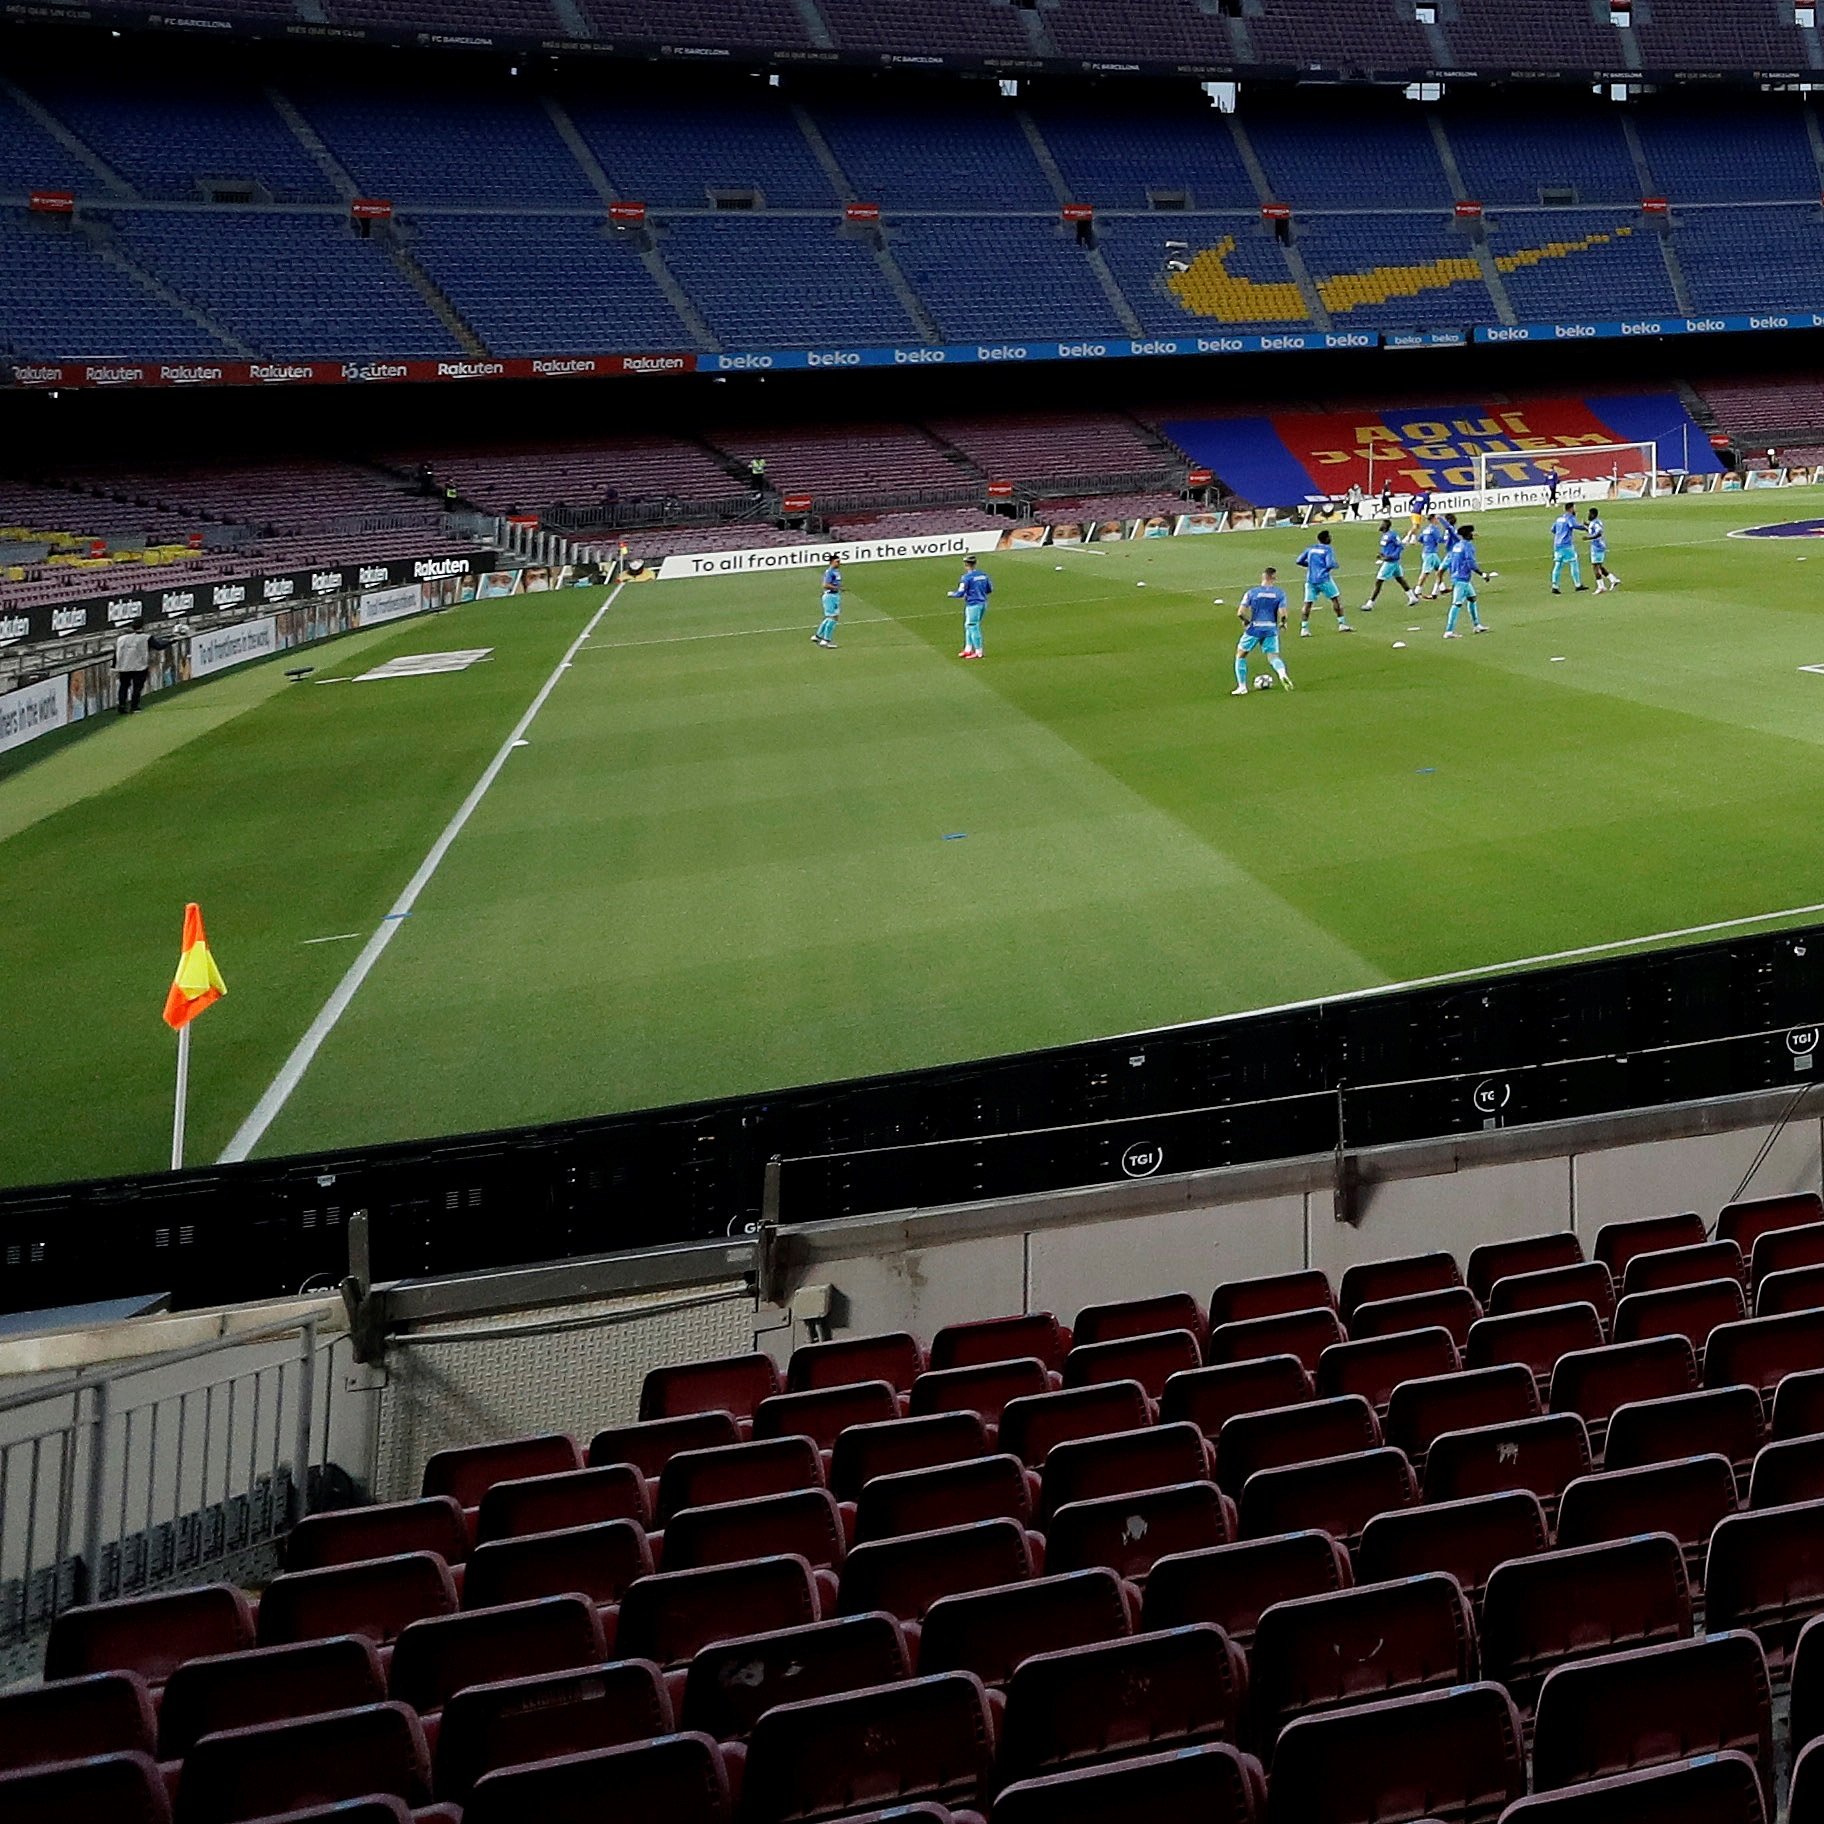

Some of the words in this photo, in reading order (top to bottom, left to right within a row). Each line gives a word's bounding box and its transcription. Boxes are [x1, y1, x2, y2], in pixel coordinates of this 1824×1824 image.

[177, 18, 232, 29] BARCELONA
[1621, 322, 1661, 334] beko
[1686, 320, 1725, 332] beko
[1750, 316, 1788, 328] beko
[1431, 333, 1460, 343] beko
[1487, 327, 1529, 340] beko
[1555, 325, 1596, 337] beko
[1197, 338, 1243, 352] beko
[1260, 336, 1305, 349] beko
[1325, 333, 1369, 347] beko
[1394, 336, 1423, 345] beko
[977, 346, 1027, 360] beko
[1058, 342, 1106, 356] beko
[1131, 341, 1177, 354] beko
[623, 356, 684, 370] Rakuten
[718, 354, 773, 368] beko
[807, 351, 860, 365] beko
[894, 349, 945, 363] beko
[250, 364, 313, 379] Rakuten
[438, 362, 504, 377] Rakuten
[532, 358, 596, 373] Rakuten
[86, 366, 144, 382] Rakuten
[160, 366, 222, 381] Rakuten
[1311, 432, 1613, 464] JUGUEM
[1398, 458, 1570, 489] TOTS
[1498, 491, 1510, 503] in
[1514, 488, 1538, 502] the
[692, 559, 715, 573] To
[720, 556, 743, 571] all
[748, 548, 850, 569] frontliners
[855, 545, 871, 560] in
[875, 543, 907, 558] the
[911, 537, 970, 556] world,
[413, 558, 470, 578] Rakuten
[1792, 1033, 1812, 1046] TGI
[1128, 1152, 1153, 1168] TGI
